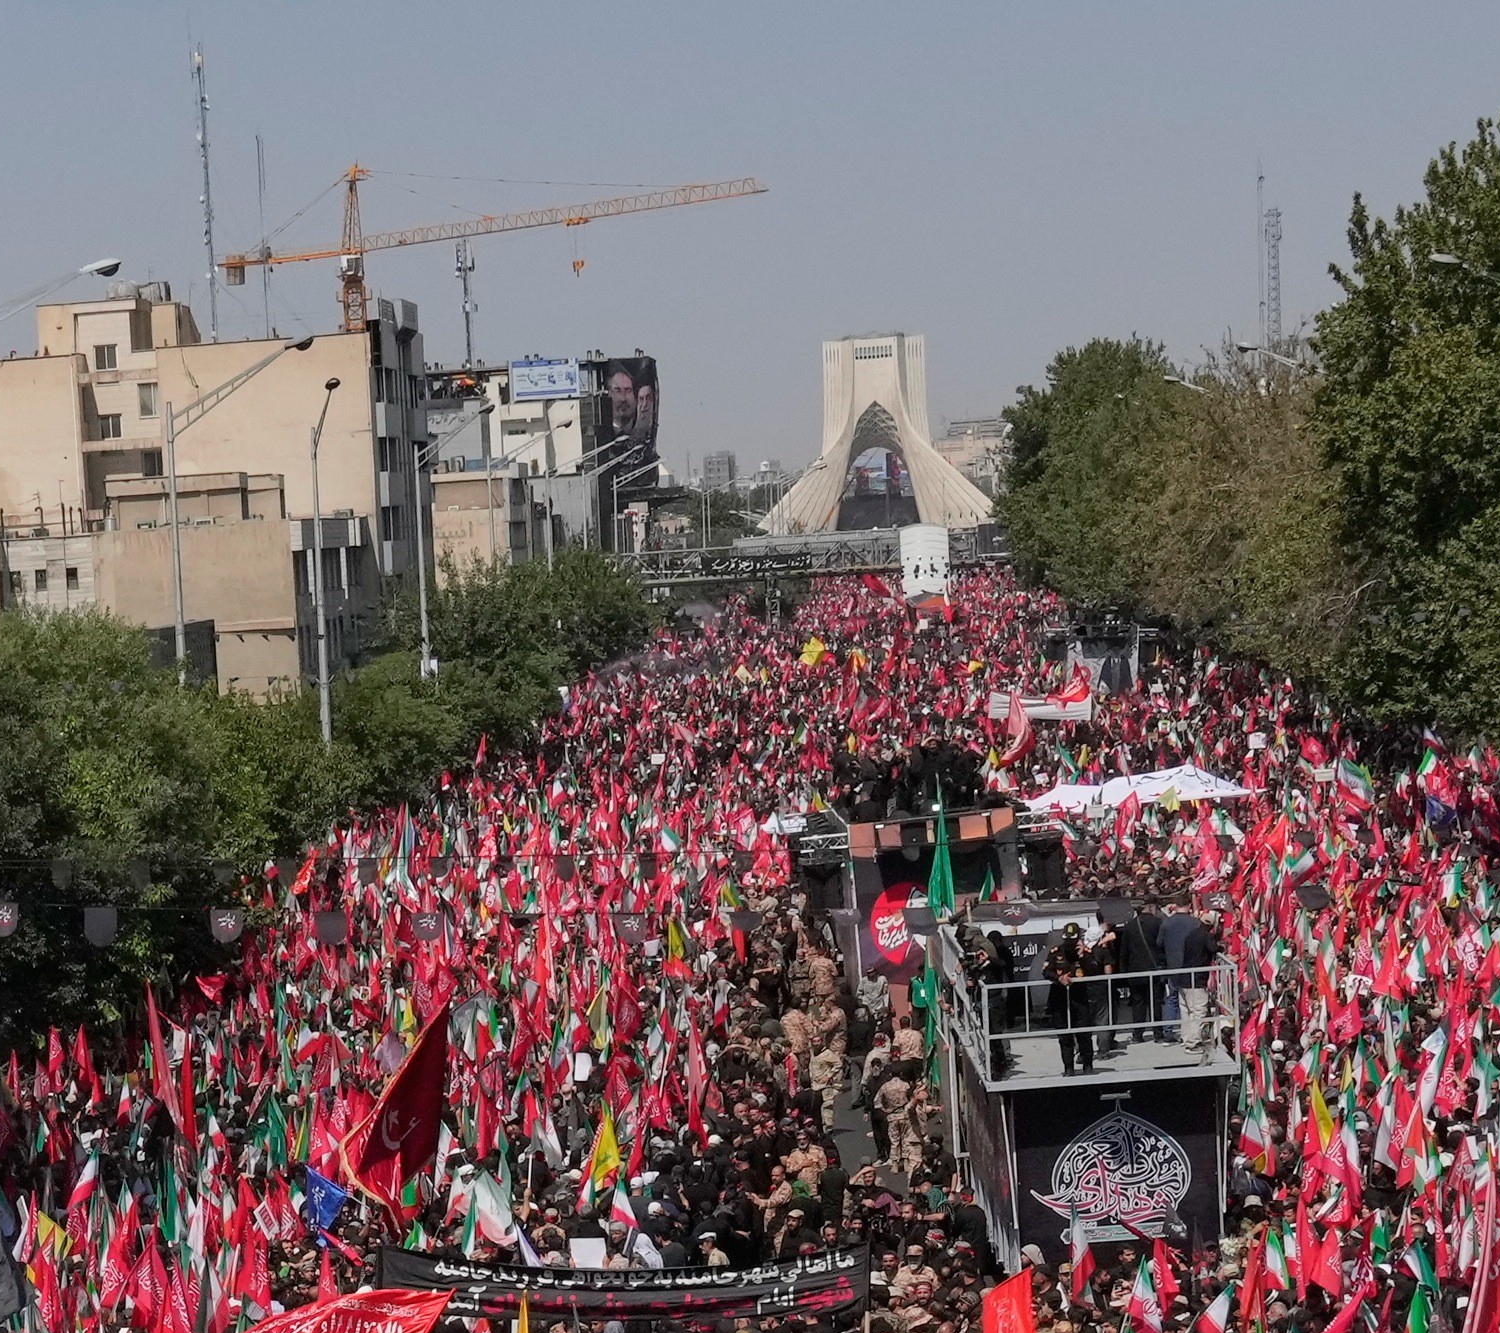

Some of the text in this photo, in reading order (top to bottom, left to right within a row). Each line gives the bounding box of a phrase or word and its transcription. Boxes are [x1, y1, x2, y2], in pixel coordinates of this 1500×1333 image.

[780, 1254, 831, 1282] اهالی
[834, 1252, 855, 1267] ما
[652, 1268, 672, 1288] به
[737, 1265, 779, 1287] شهر
[755, 1285, 794, 1314] امام
